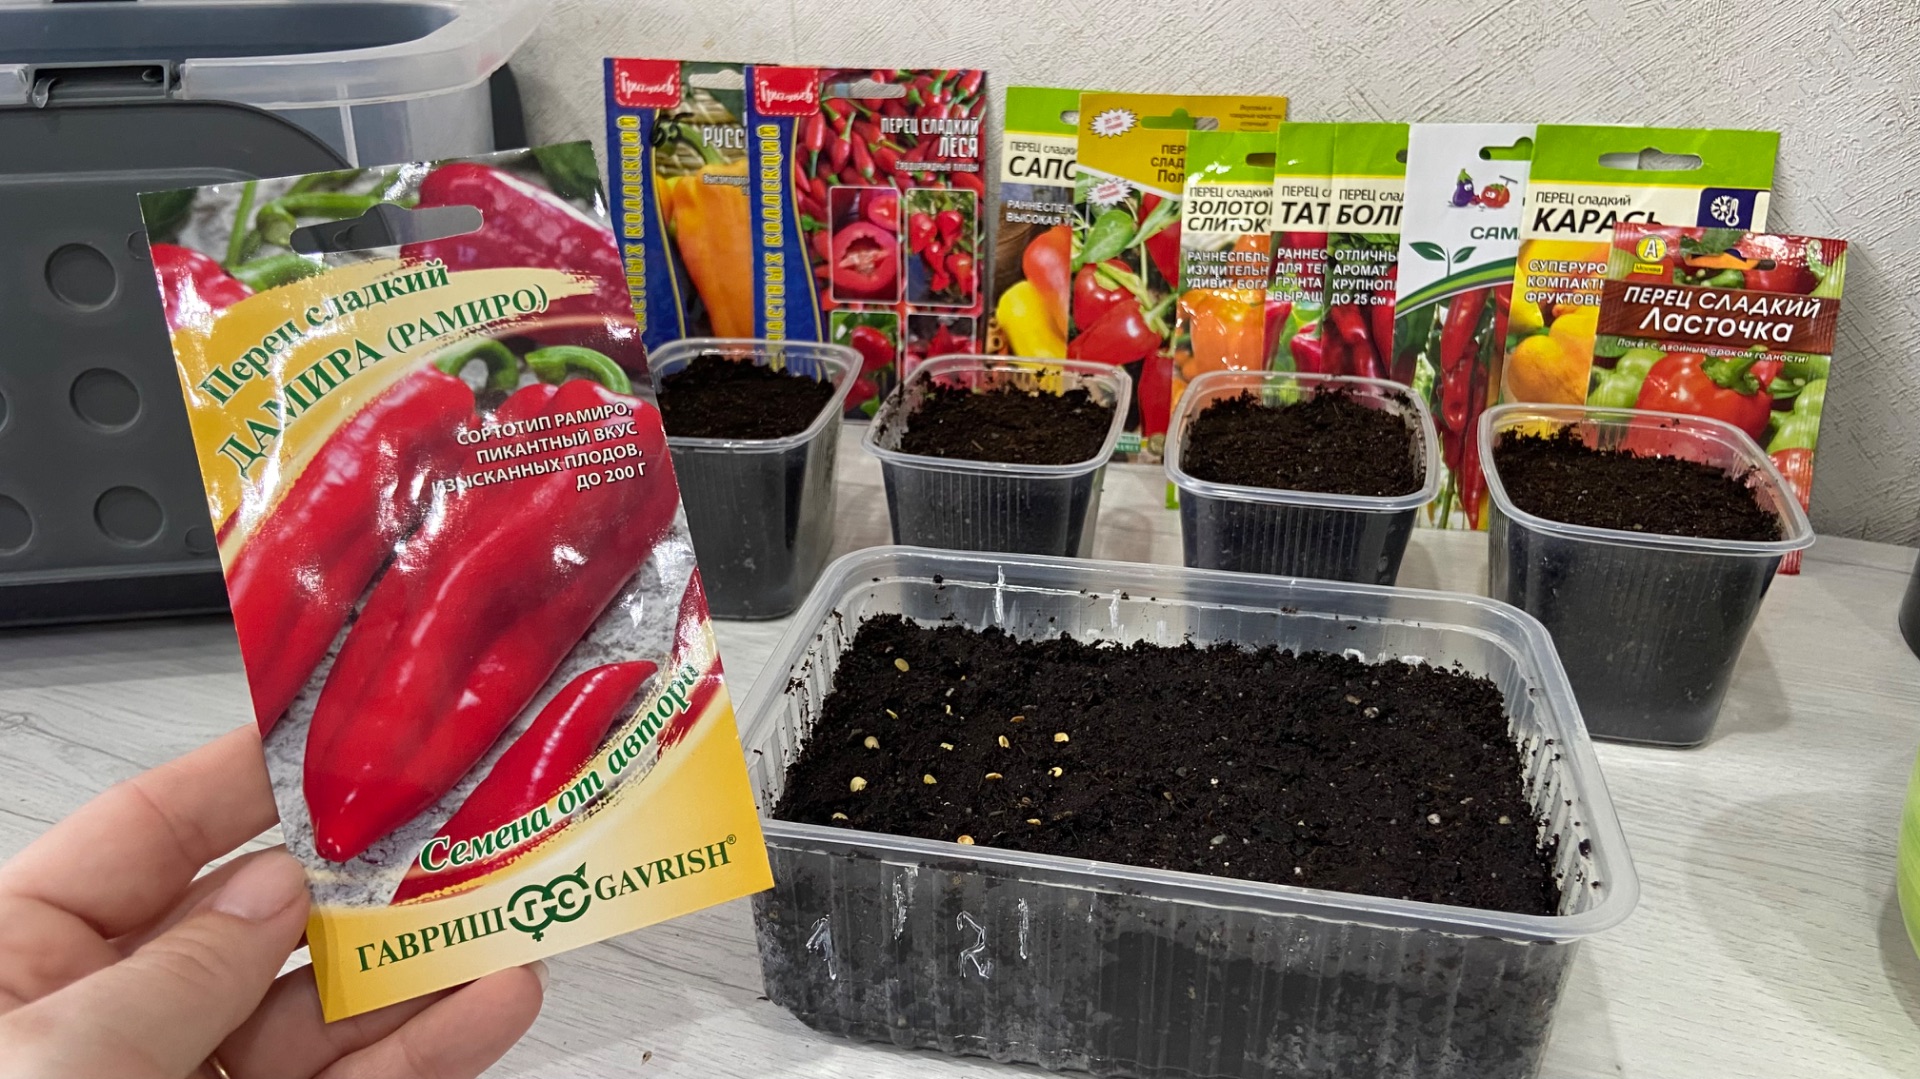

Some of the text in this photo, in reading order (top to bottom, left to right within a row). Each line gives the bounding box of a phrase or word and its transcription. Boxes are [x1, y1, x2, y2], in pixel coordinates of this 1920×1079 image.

[881, 117, 979, 136] ПЕРЕЦ СЛАДКИЙ
[937, 137, 978, 158] ЛЕСЯ
[1010, 141, 1040, 154] ПЕРЕЦ
[616, 115, 645, 239] КОЛЛЕКЦИЙ
[756, 124, 784, 247] КОЛЛЕКЦИЙ
[1189, 186, 1273, 198] ПЕРЕЦ сладкий
[1282, 186, 1319, 198] ПЕРЕЦ
[1339, 189, 1376, 202] ПЕРЕЦ
[1535, 191, 1631, 207] ПЕРЕЦ сладкий
[1006, 212, 1061, 225] ВЫСОКАЯ
[1470, 226, 1520, 240] САМ
[1275, 262, 1302, 275] ДЛЯ
[1186, 277, 1234, 289] УДИВИТ
[1275, 277, 1322, 288] ГРУНТА
[1332, 279, 1396, 291] КРУПНОП
[1331, 293, 1386, 306] ДО 25 см
[1623, 286, 1821, 318] ПЕРЕЦ СЛАДКИЙ
[197, 259, 450, 405] Перец сладкий
[1639, 306, 1794, 343] Ласточка
[217, 283, 550, 480] ДАМИРА (РАМИРО)
[456, 402, 633, 446] СОРТОТИП РАМИРО,
[476, 421, 638, 465] ПИКАНТНЫЙ ВКУС
[431, 443, 643, 495] ИЗЫСКАННЫХ ПЛОДОВ,
[576, 462, 647, 492] ДО 200 Г
[420, 662, 700, 872] Семена от автора
[355, 907, 508, 973] ГАВРИШ
